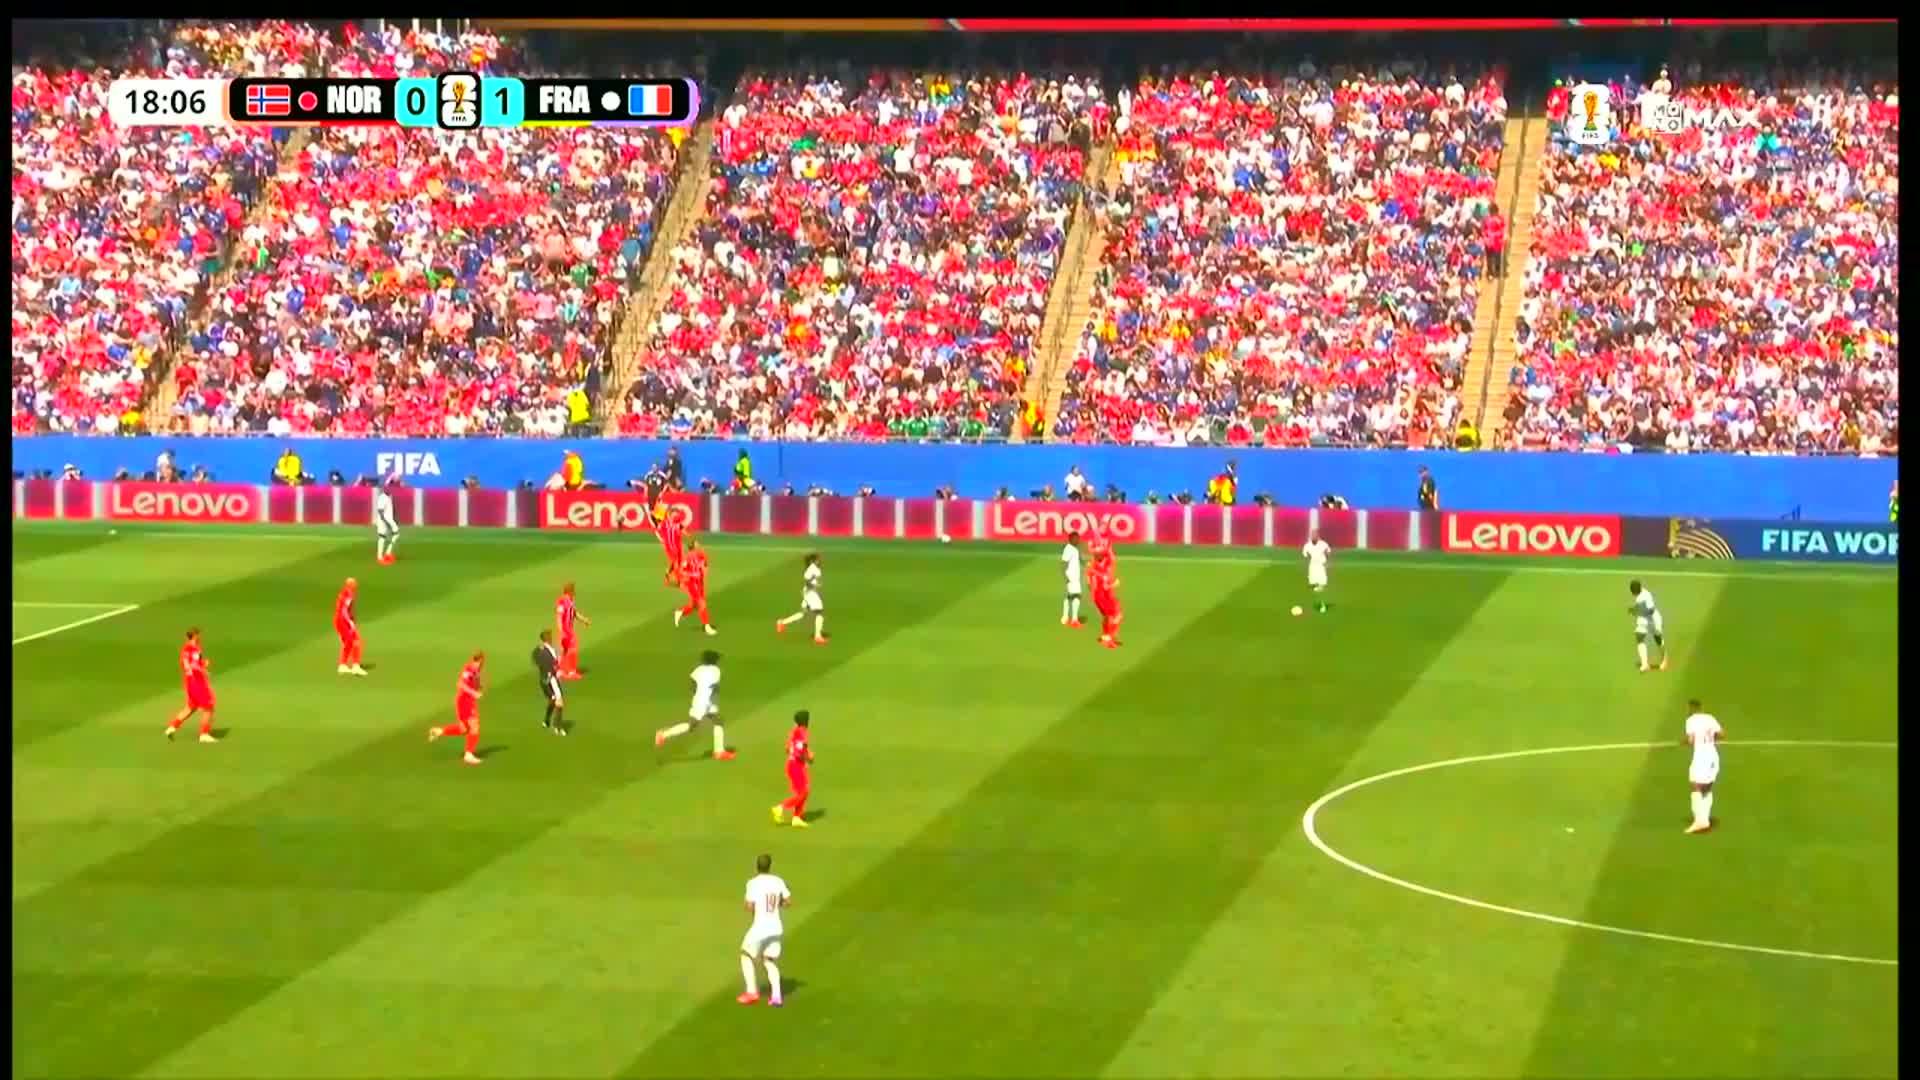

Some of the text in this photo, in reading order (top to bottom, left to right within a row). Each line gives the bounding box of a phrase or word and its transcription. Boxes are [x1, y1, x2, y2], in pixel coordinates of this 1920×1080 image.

[377, 452, 441, 475] FIFA
[112, 484, 249, 517] Lenovo
[1448, 514, 1611, 552] Lenovo
[1762, 529, 1829, 553] FIFA
